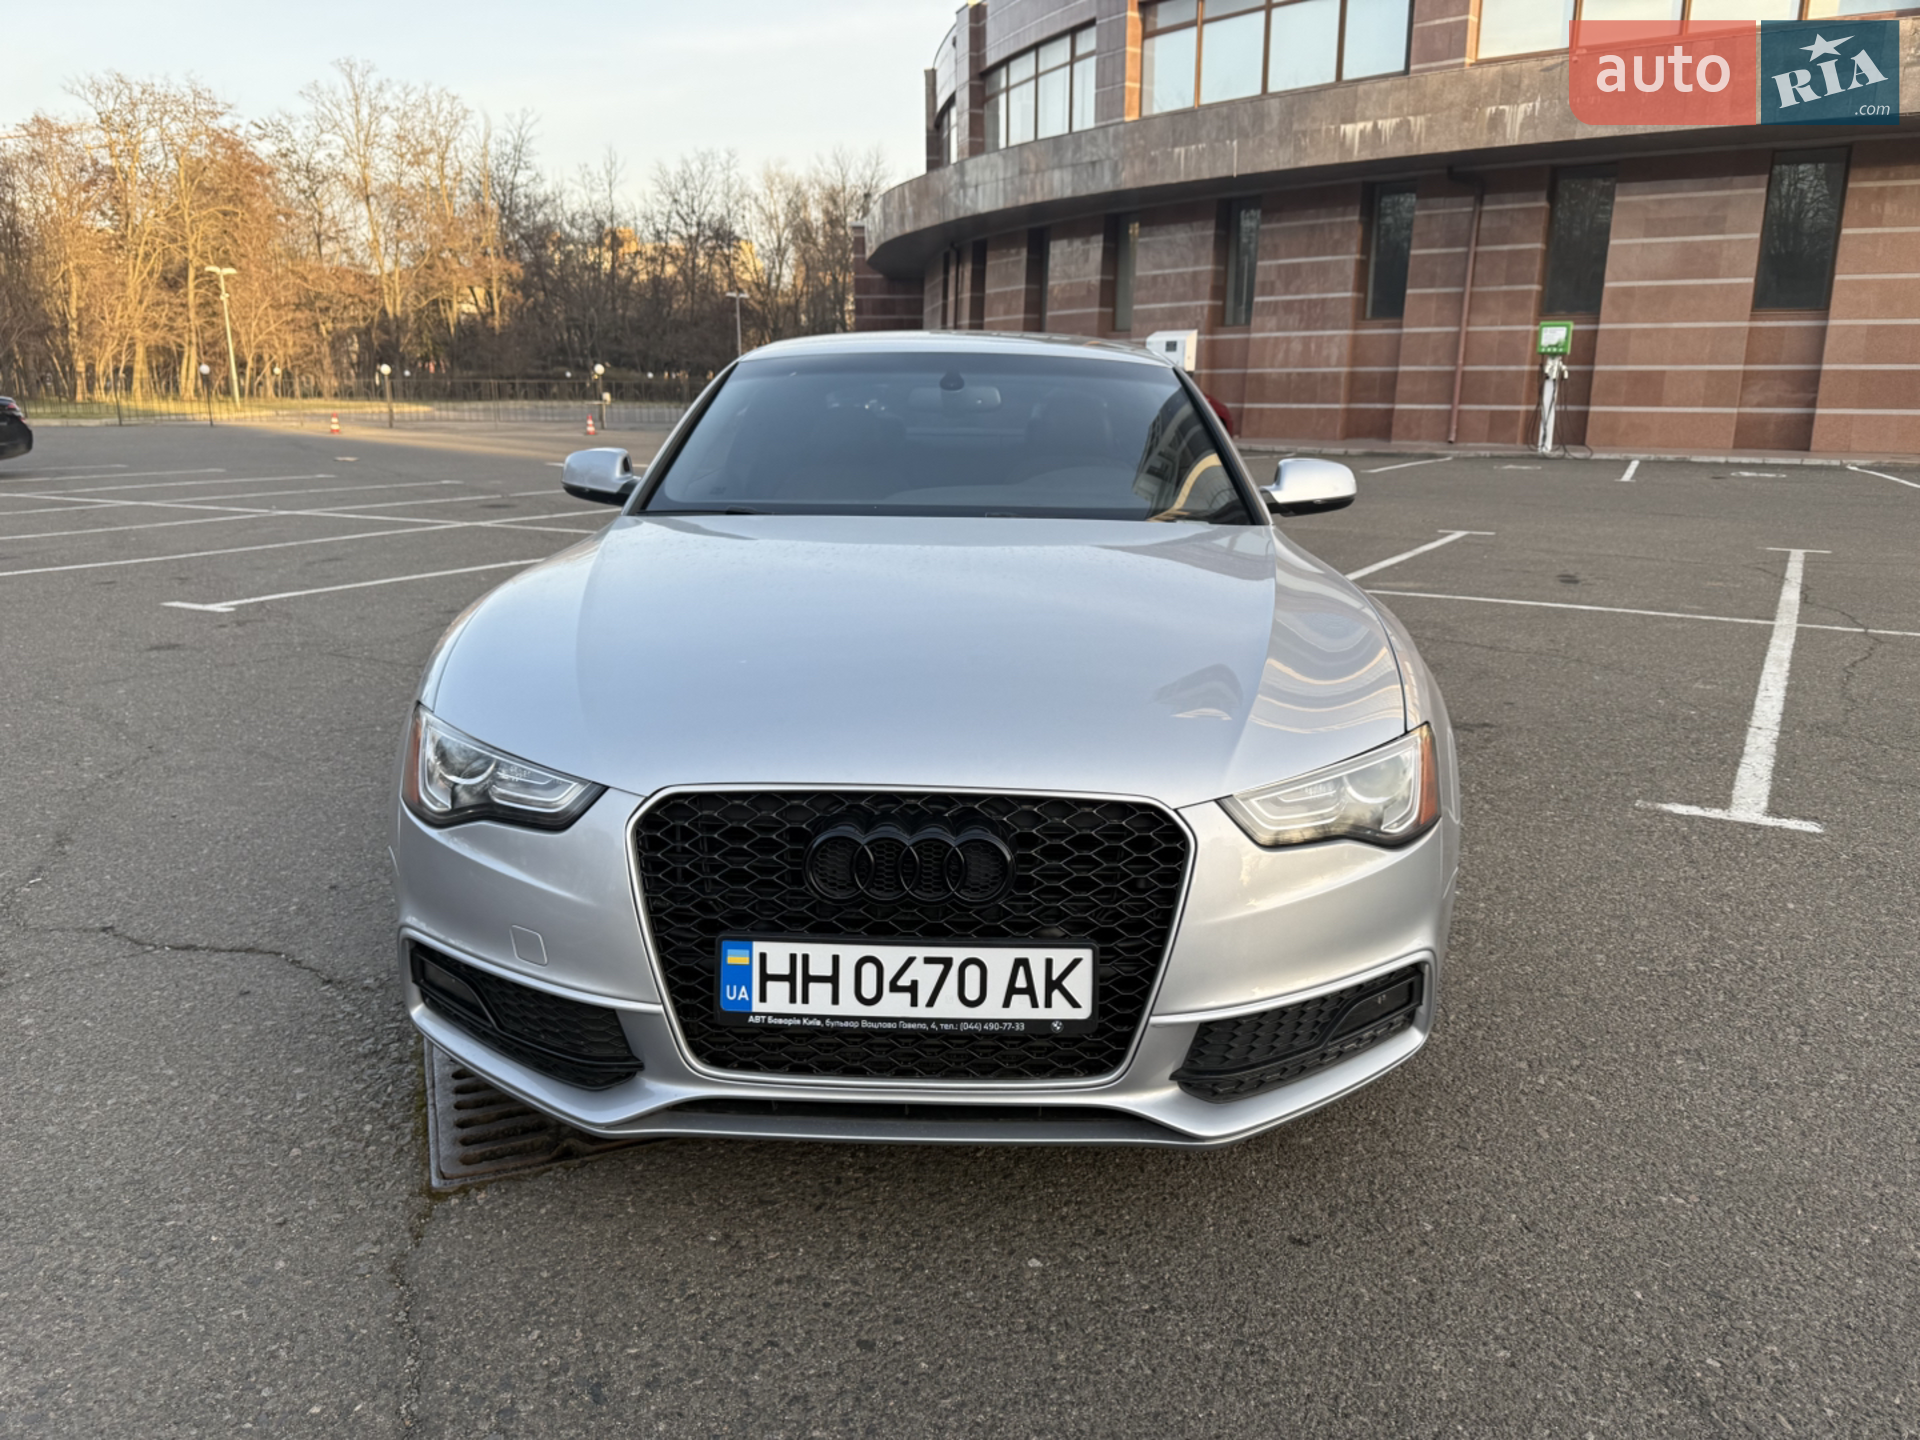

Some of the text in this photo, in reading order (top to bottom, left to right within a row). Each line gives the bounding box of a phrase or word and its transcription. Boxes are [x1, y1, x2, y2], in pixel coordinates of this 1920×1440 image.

[853, 955, 988, 1008] 0470
[726, 984, 749, 1001] UA
[960, 1021, 982, 1032] (044)
[983, 1021, 1025, 1031] 490-77-33
